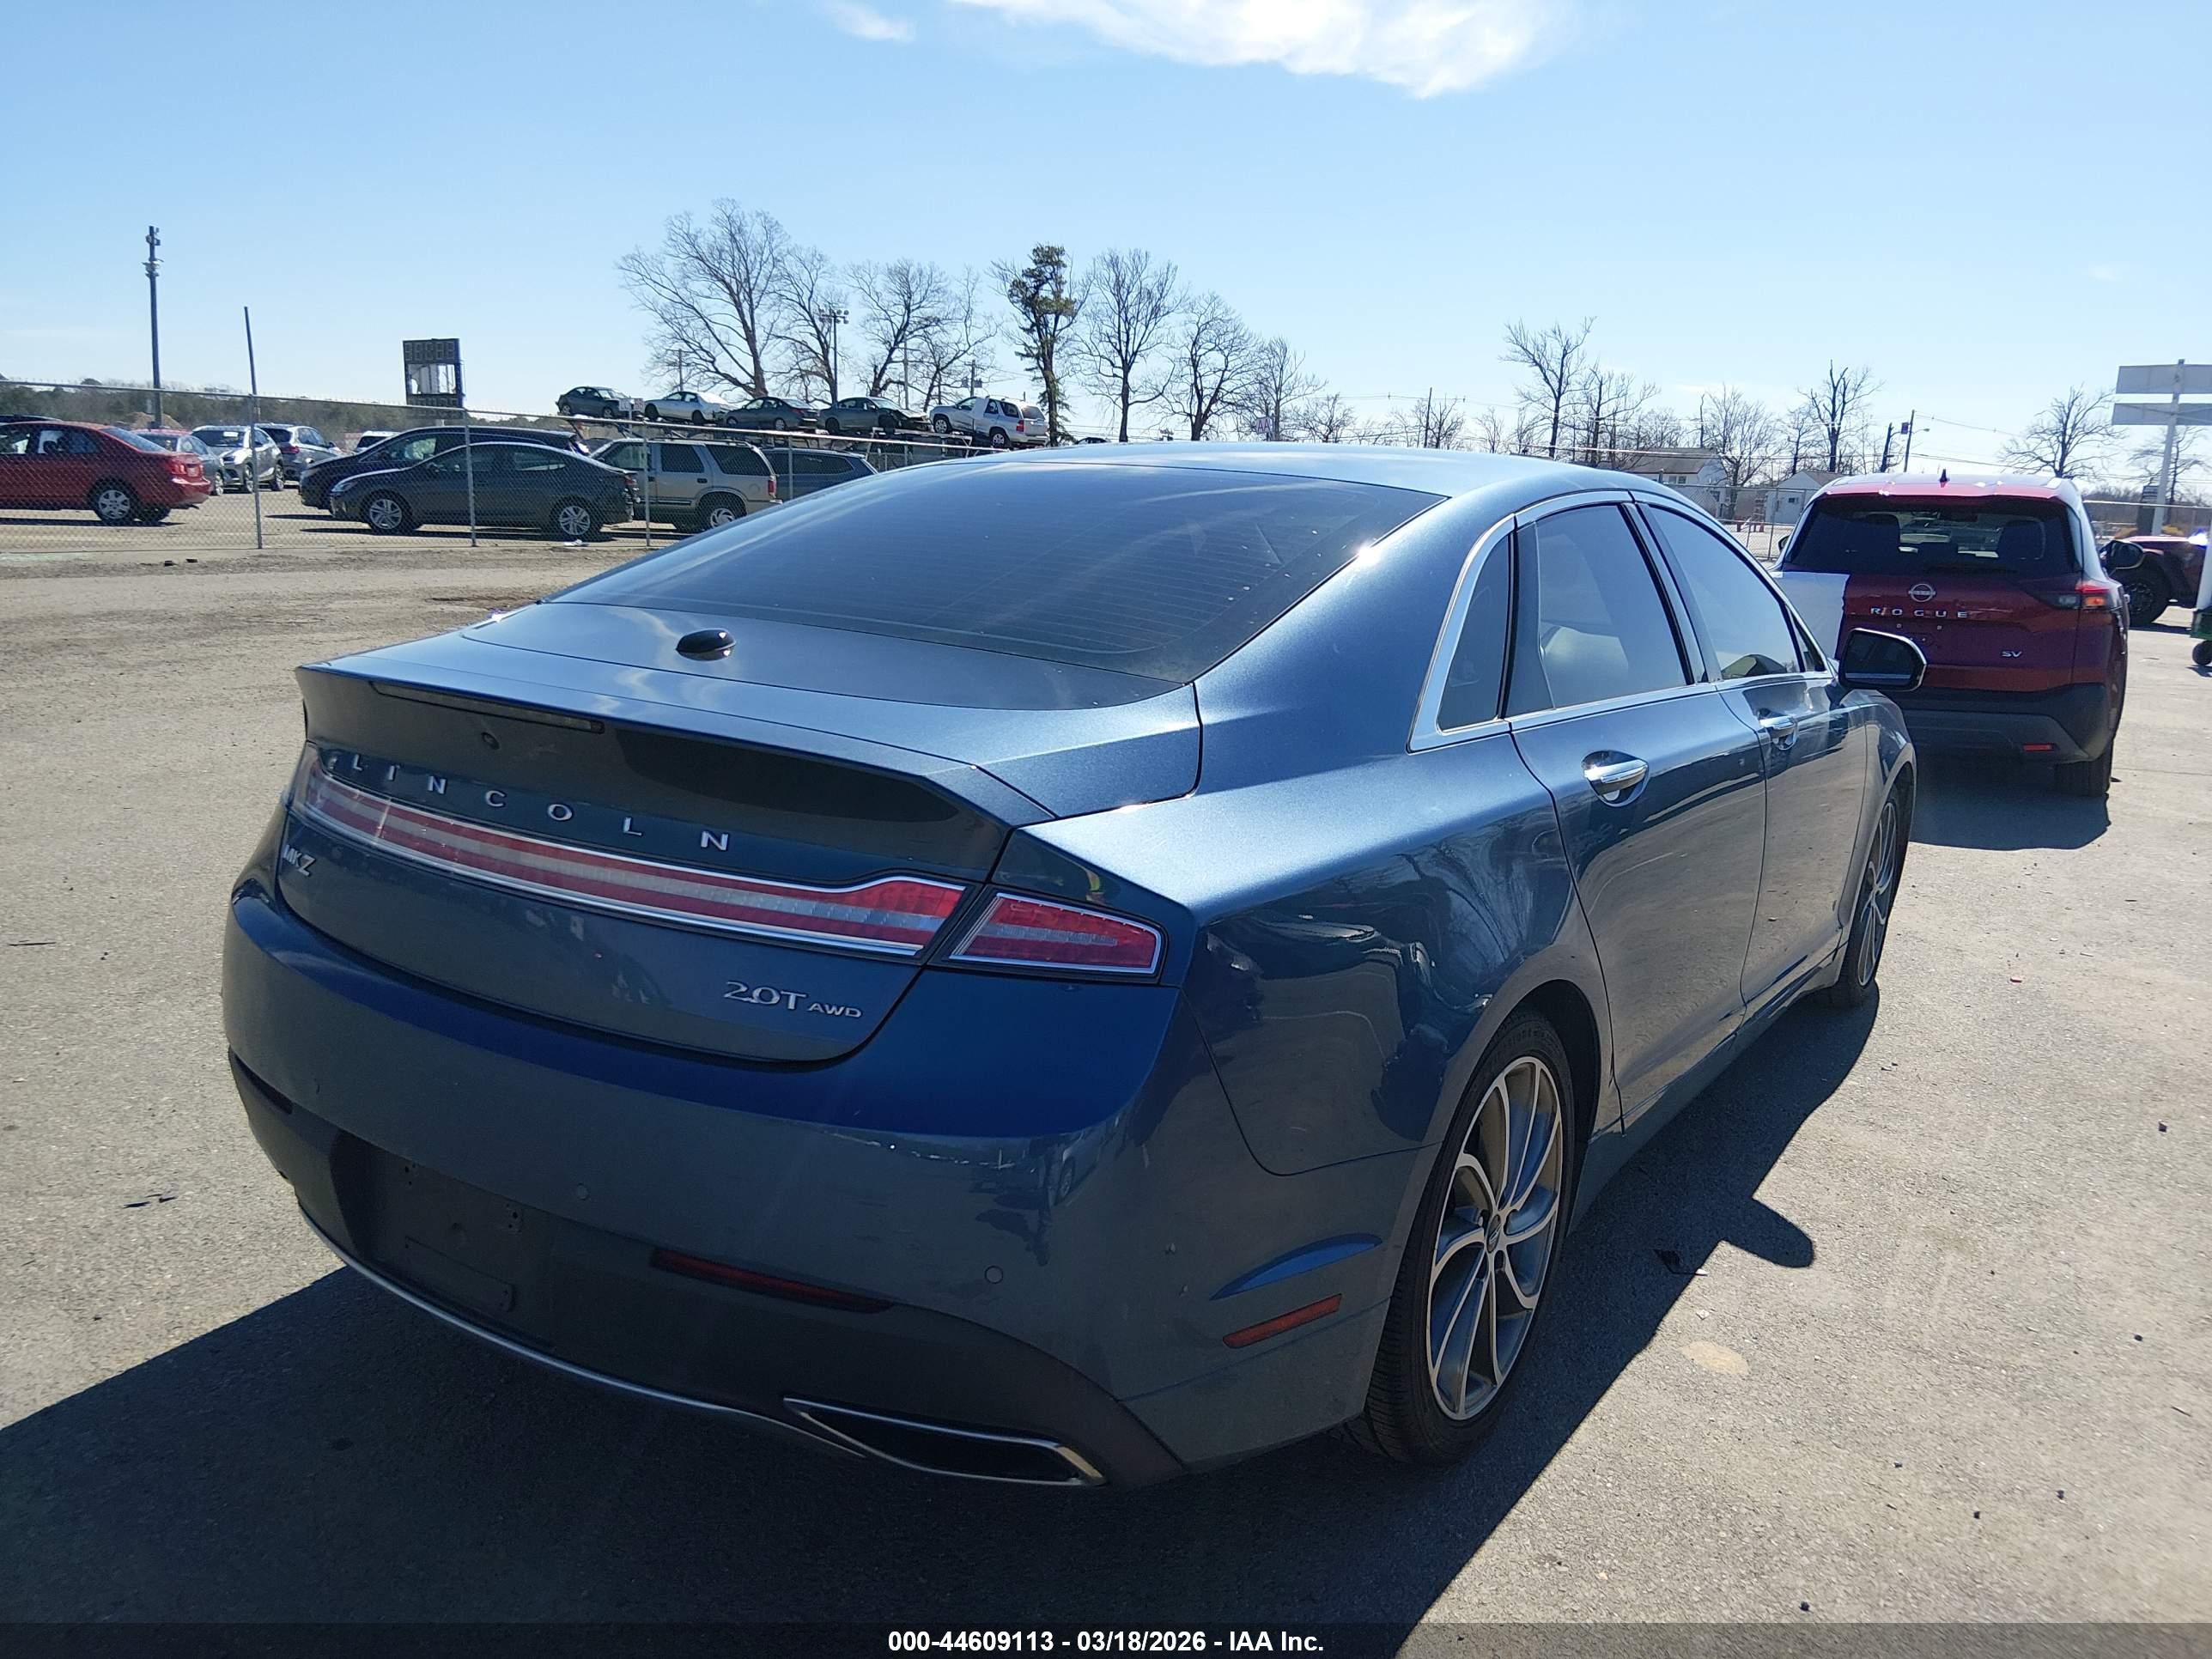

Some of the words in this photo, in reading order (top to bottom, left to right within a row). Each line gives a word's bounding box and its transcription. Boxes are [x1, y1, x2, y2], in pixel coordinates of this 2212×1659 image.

[1870, 607, 1968, 618] ROGUE
[352, 753, 728, 851] LINCOLN
[283, 844, 316, 877] MKZ
[807, 1002, 862, 1018] AWD
